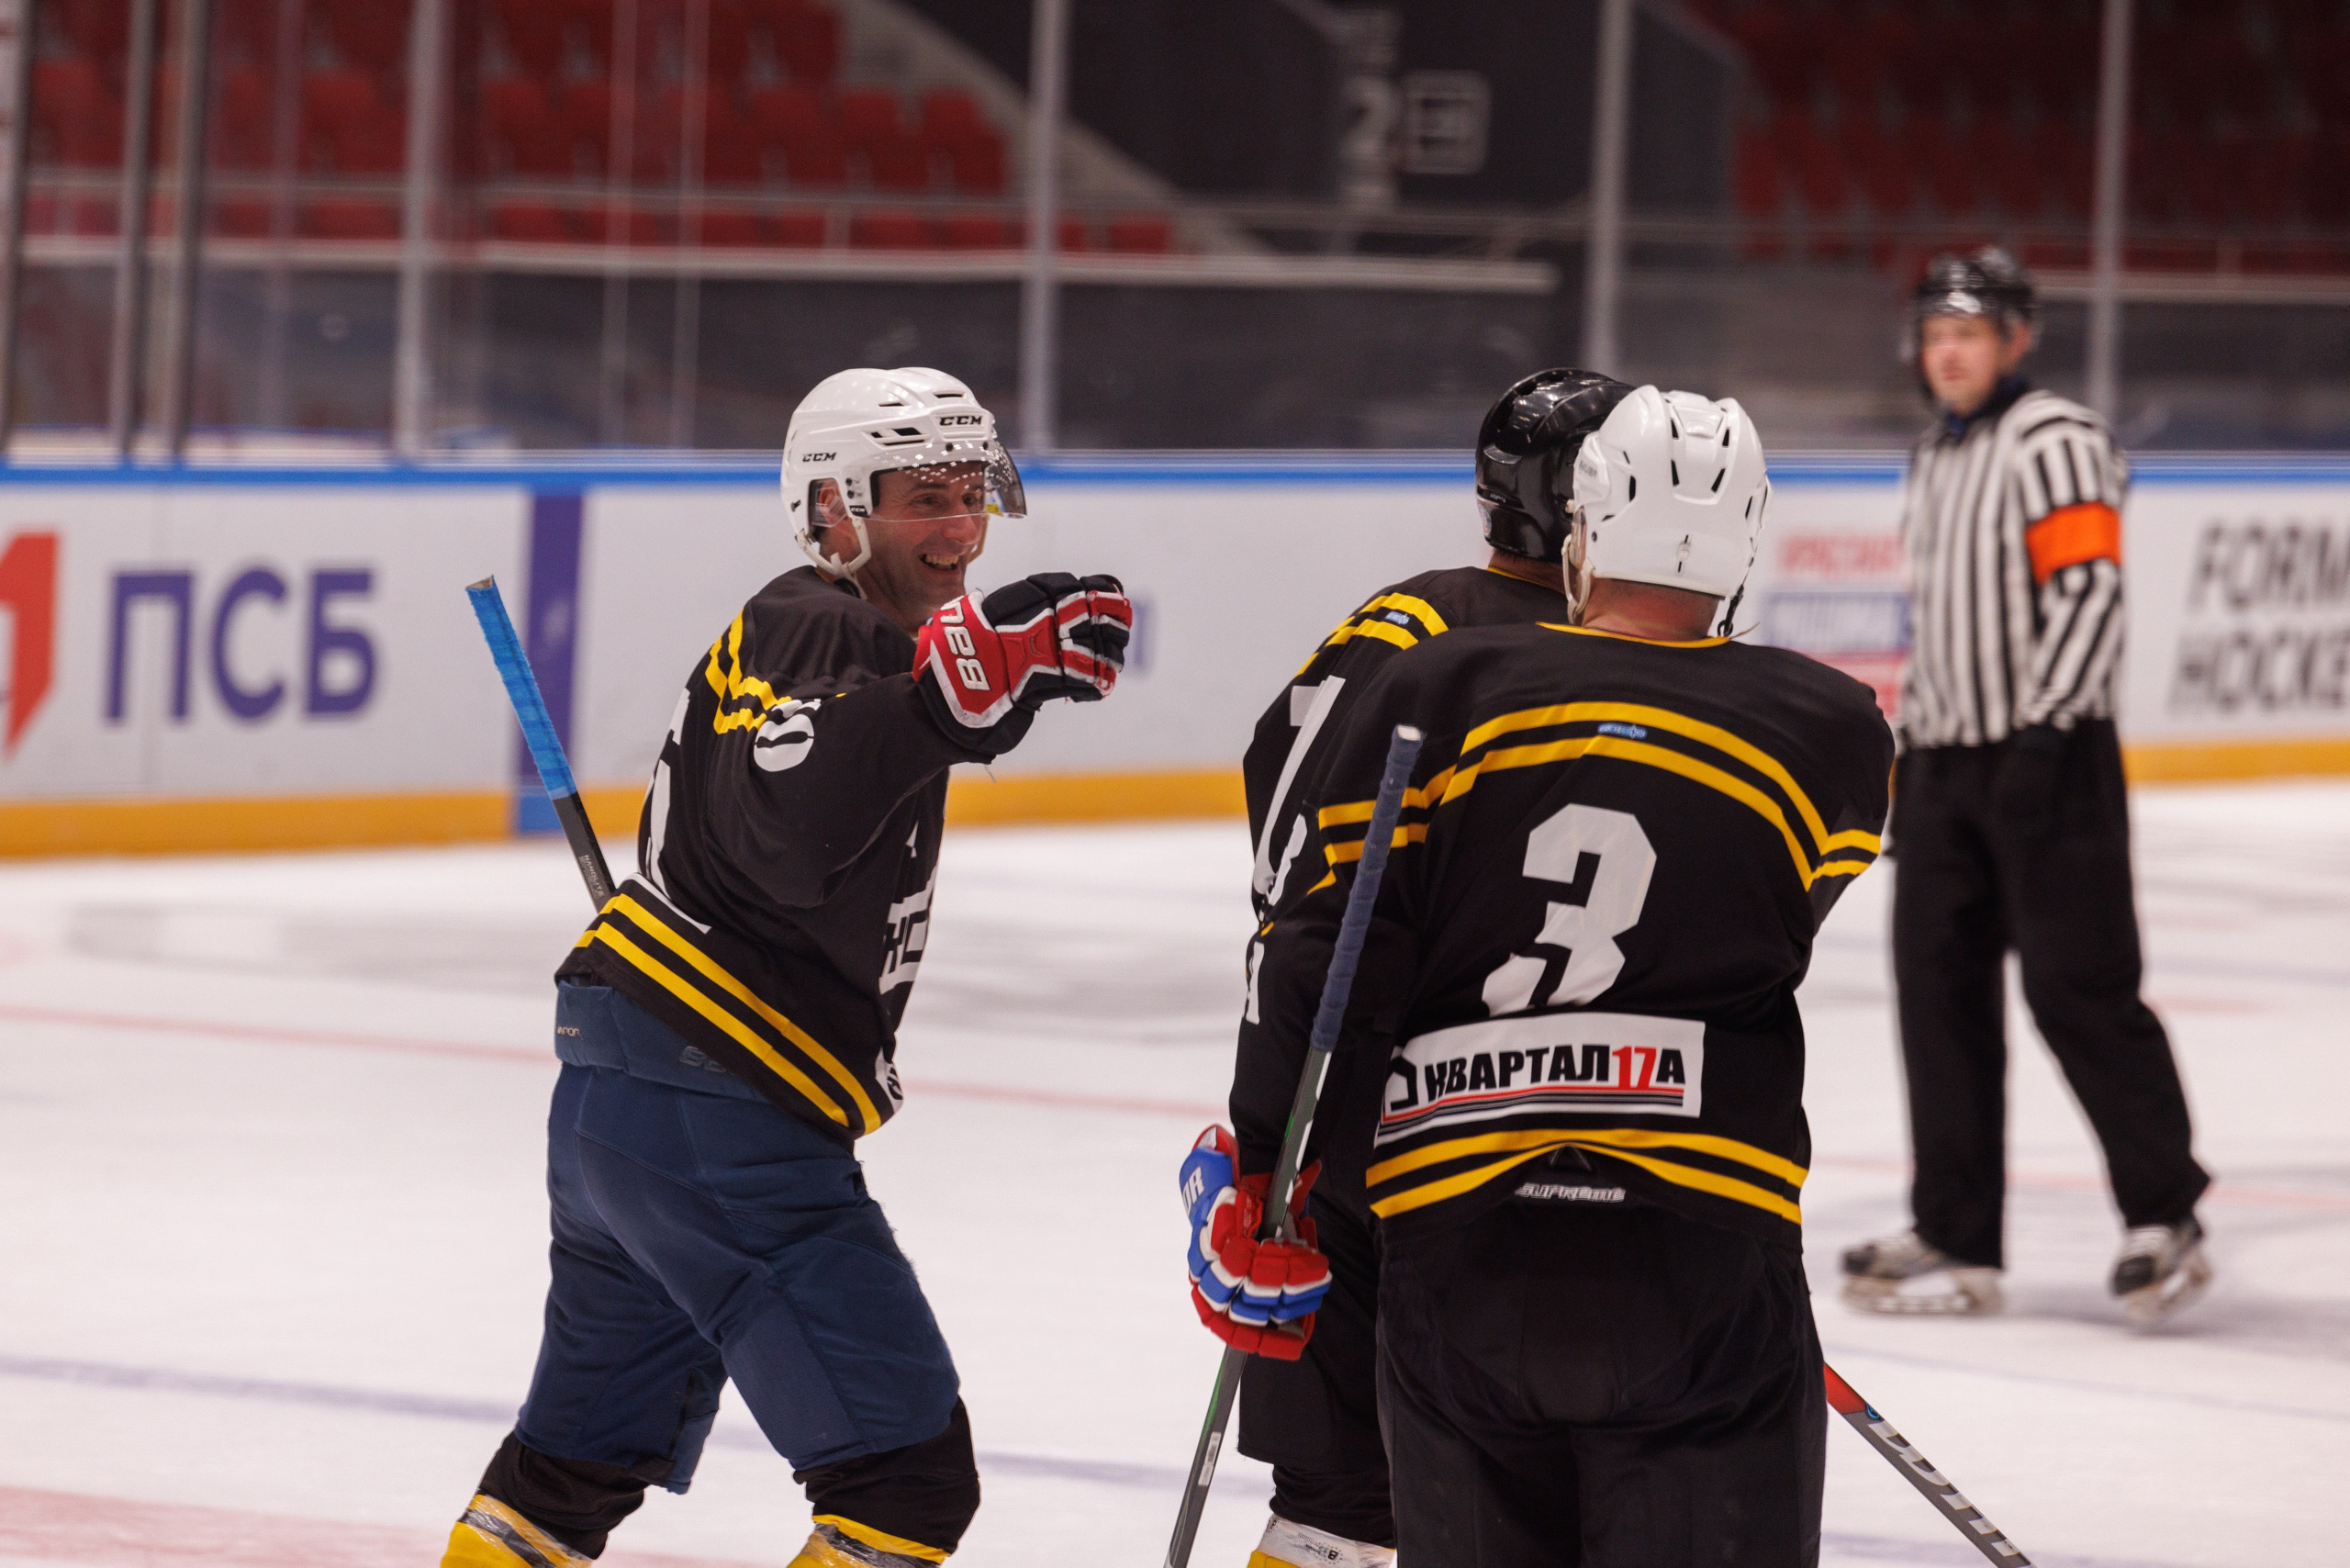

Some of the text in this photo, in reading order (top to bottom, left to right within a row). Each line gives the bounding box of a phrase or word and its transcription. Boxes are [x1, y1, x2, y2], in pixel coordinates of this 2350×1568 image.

[802, 452, 837, 463] CCM
[939, 415, 982, 426] CCM
[106, 564, 379, 722] ПСБ
[1482, 803, 1657, 1017] 3
